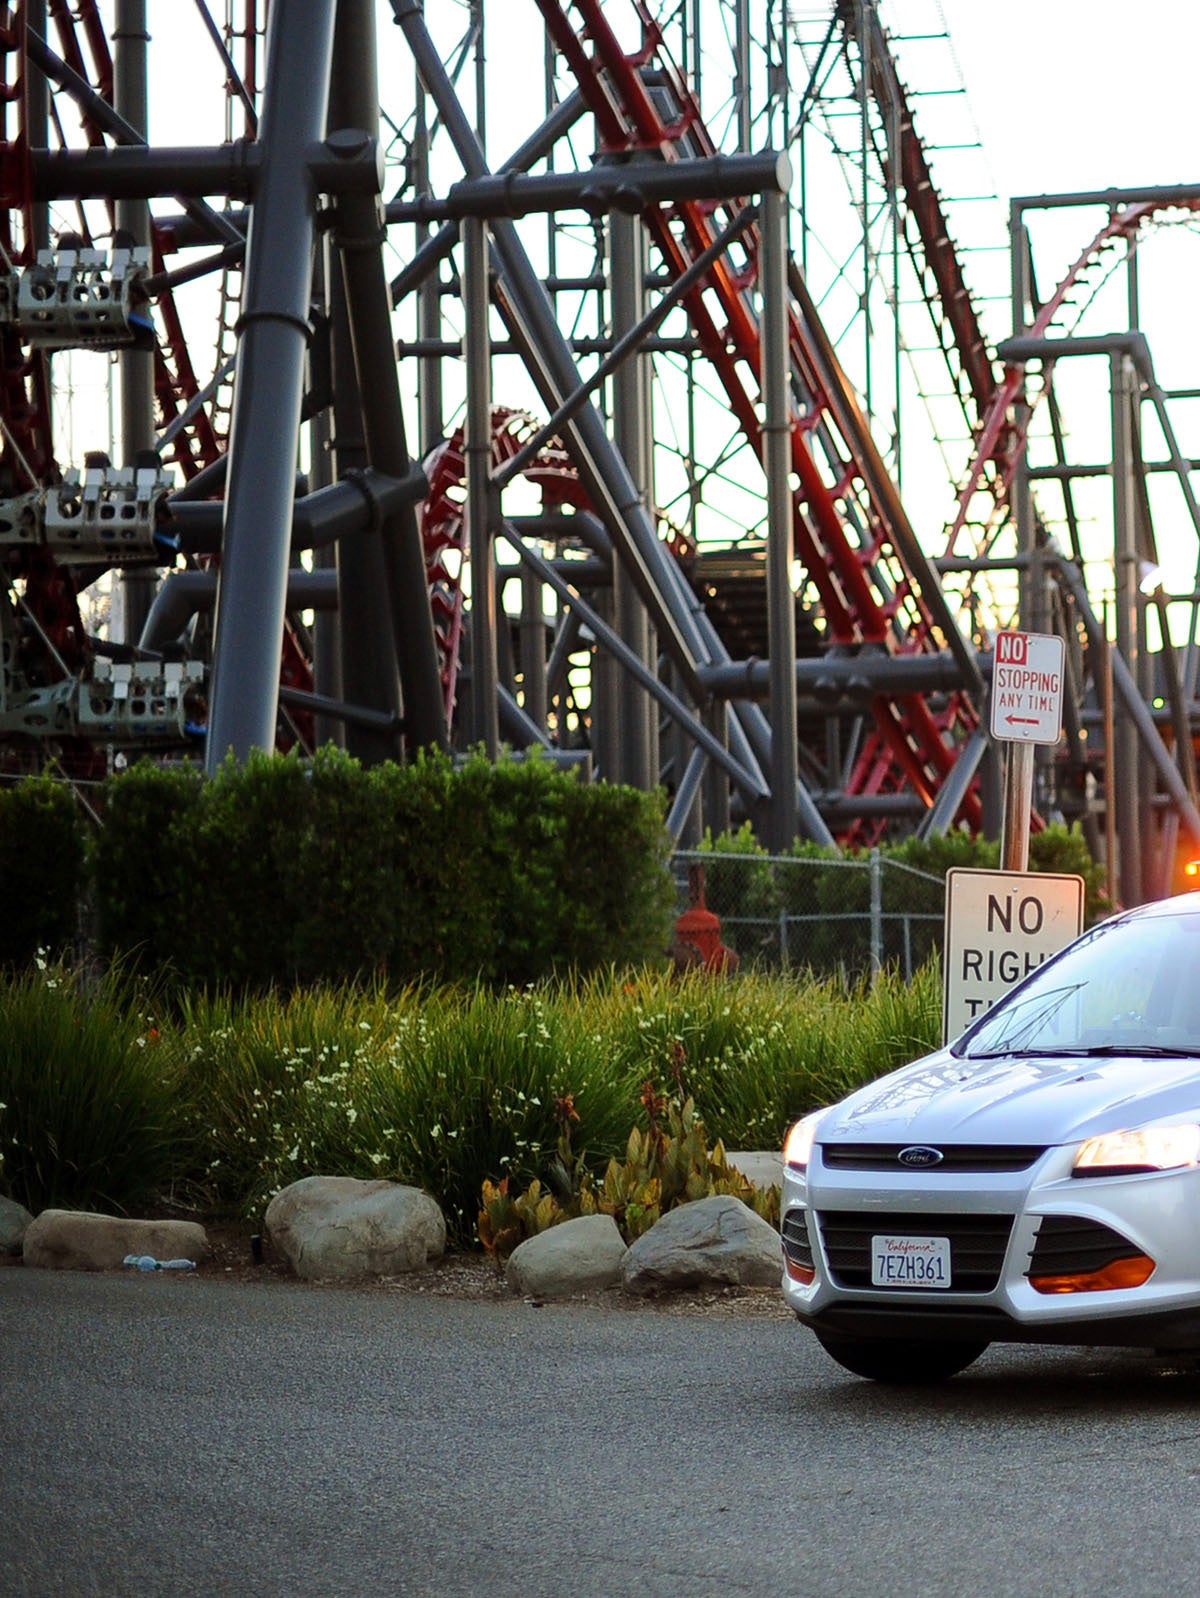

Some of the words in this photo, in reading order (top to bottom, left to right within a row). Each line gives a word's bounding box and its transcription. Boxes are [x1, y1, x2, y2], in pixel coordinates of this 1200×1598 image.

[1000, 636, 1024, 661] NO
[998, 668, 1059, 693] STOPPING
[1000, 692, 1023, 708] ANY
[1028, 694, 1054, 712] TIME
[987, 894, 1043, 935] NO
[963, 949, 1053, 984] RIGH
[887, 1240, 935, 1255] California
[877, 1255, 945, 1280] 7EZH361
